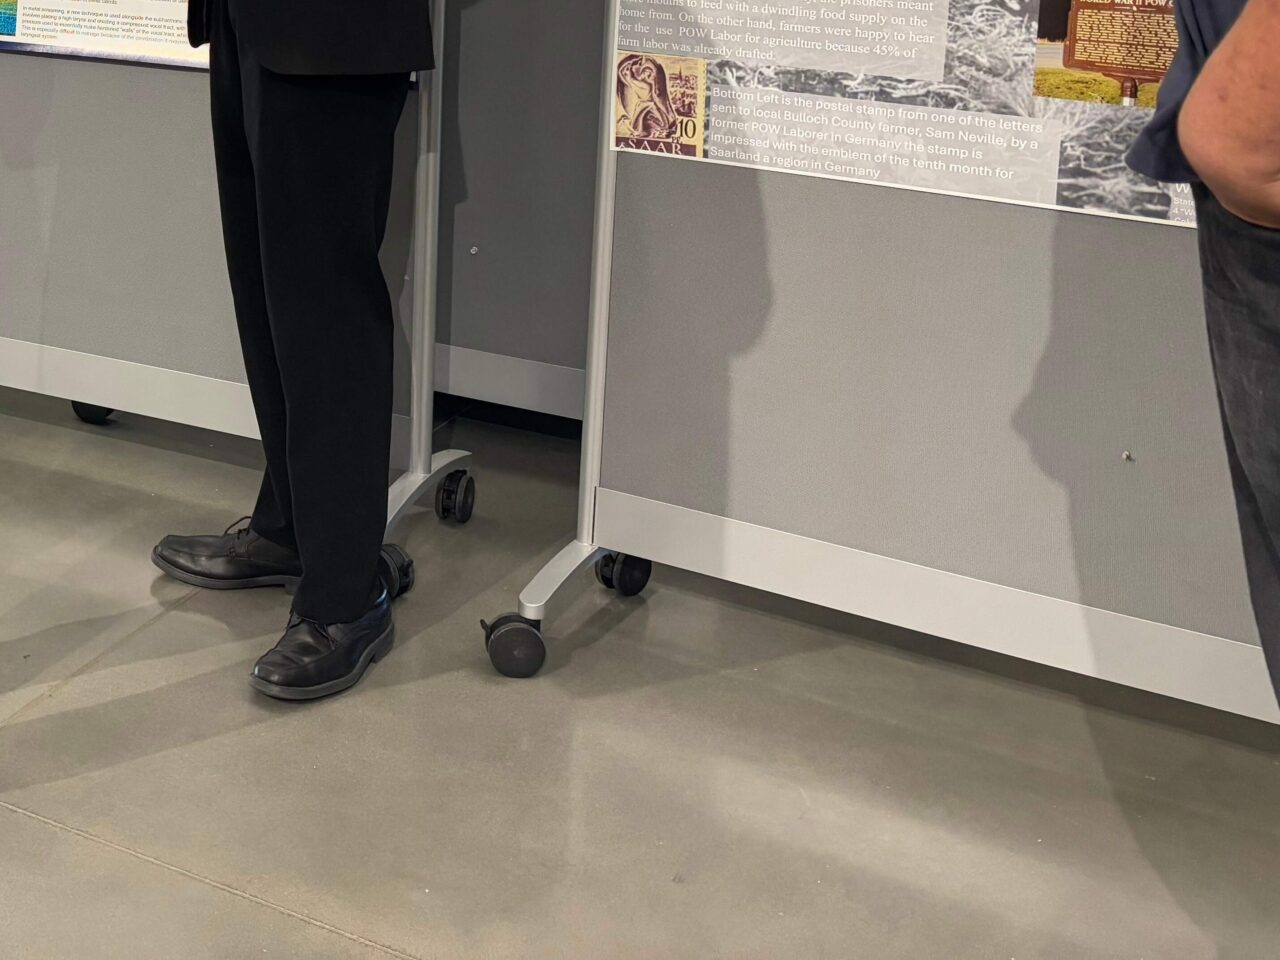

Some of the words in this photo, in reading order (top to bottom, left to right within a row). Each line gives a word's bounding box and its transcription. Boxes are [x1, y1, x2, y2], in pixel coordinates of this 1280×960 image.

[711, 87, 754, 102] Bottom
[756, 91, 779, 104] Left
[781, 94, 791, 106] is
[793, 95, 813, 108] the
[815, 98, 853, 115] postal
[855, 102, 895, 120] stamp
[897, 106, 928, 120] from
[930, 112, 955, 123] one
[958, 113, 972, 125] of
[974, 114, 996, 127] the
[999, 117, 1043, 132] letters
[677, 119, 697, 139] 10
[628, 139, 683, 155] SAAR
